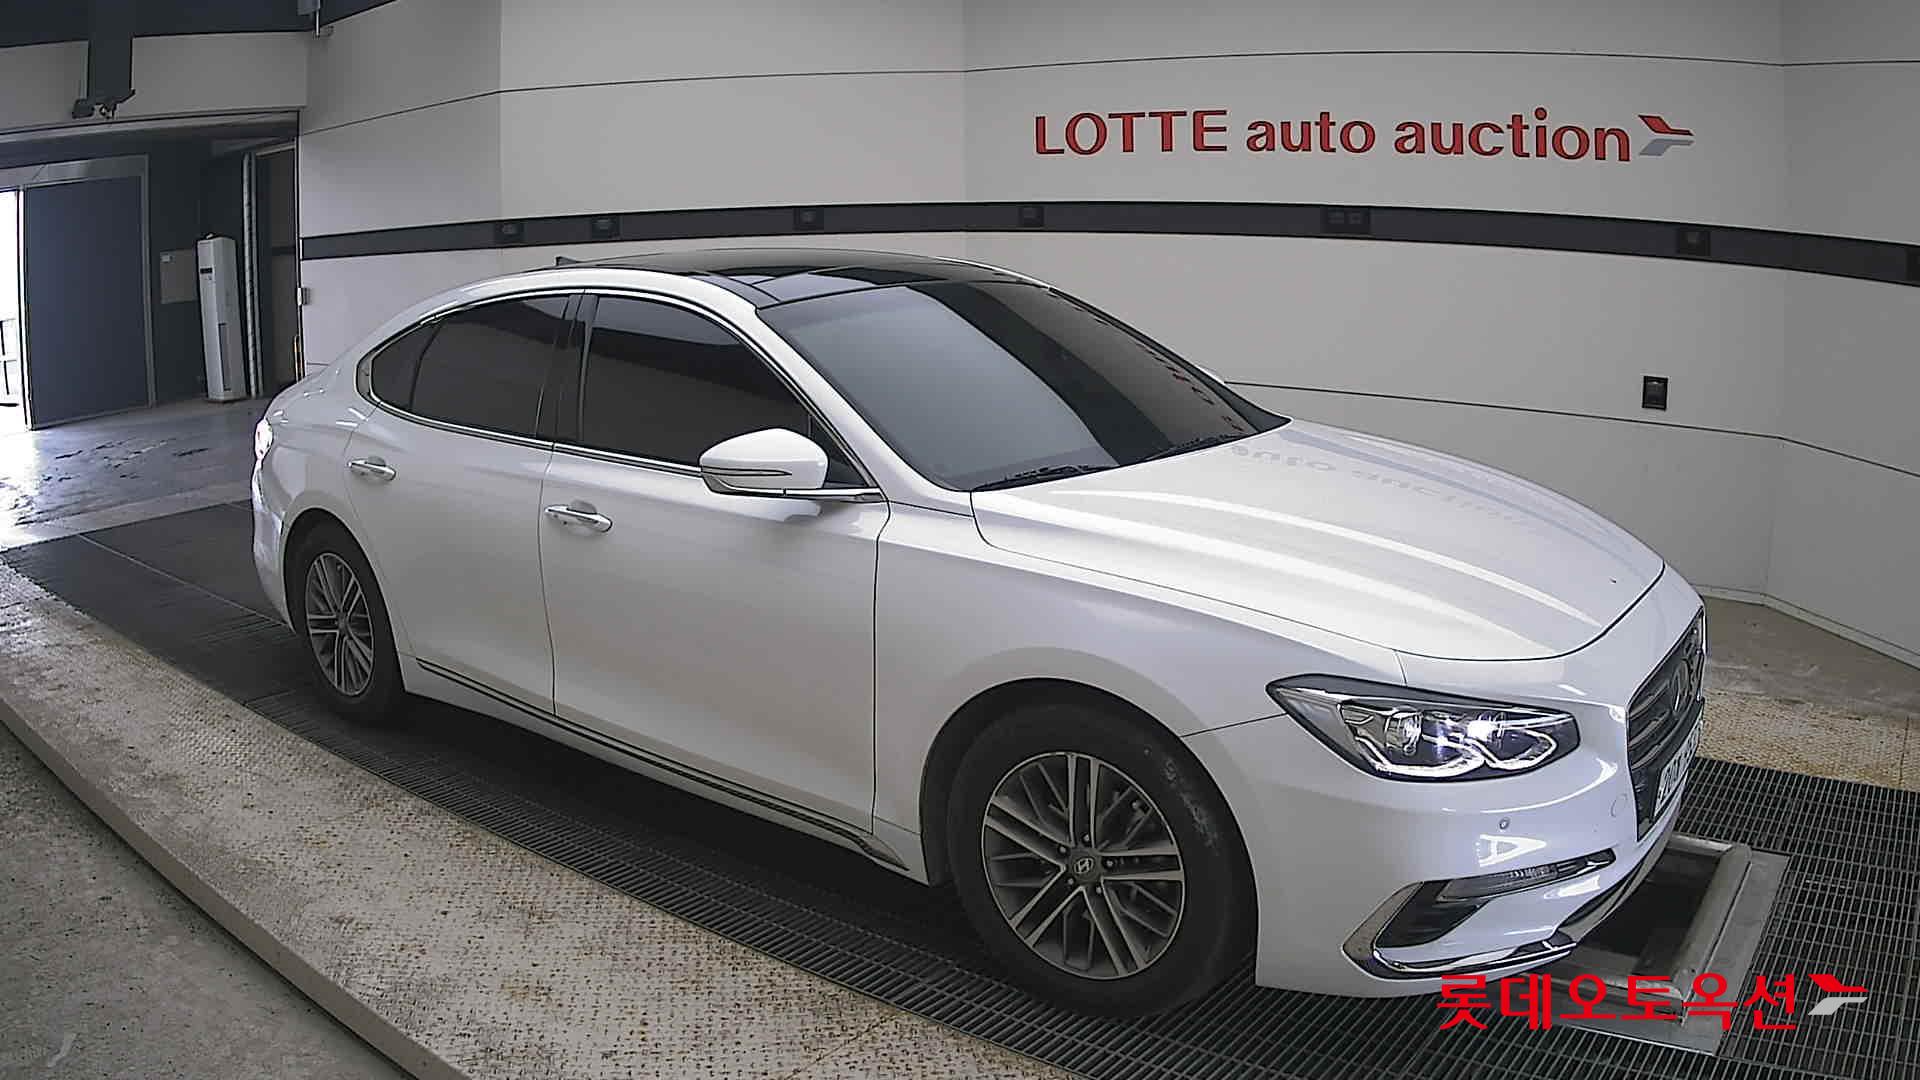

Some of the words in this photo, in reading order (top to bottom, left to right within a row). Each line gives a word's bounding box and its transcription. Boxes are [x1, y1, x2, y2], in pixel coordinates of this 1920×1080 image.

[1035, 109, 1228, 155] LOTTE
[1246, 111, 1376, 154] auto
[1394, 106, 1631, 162] auction
